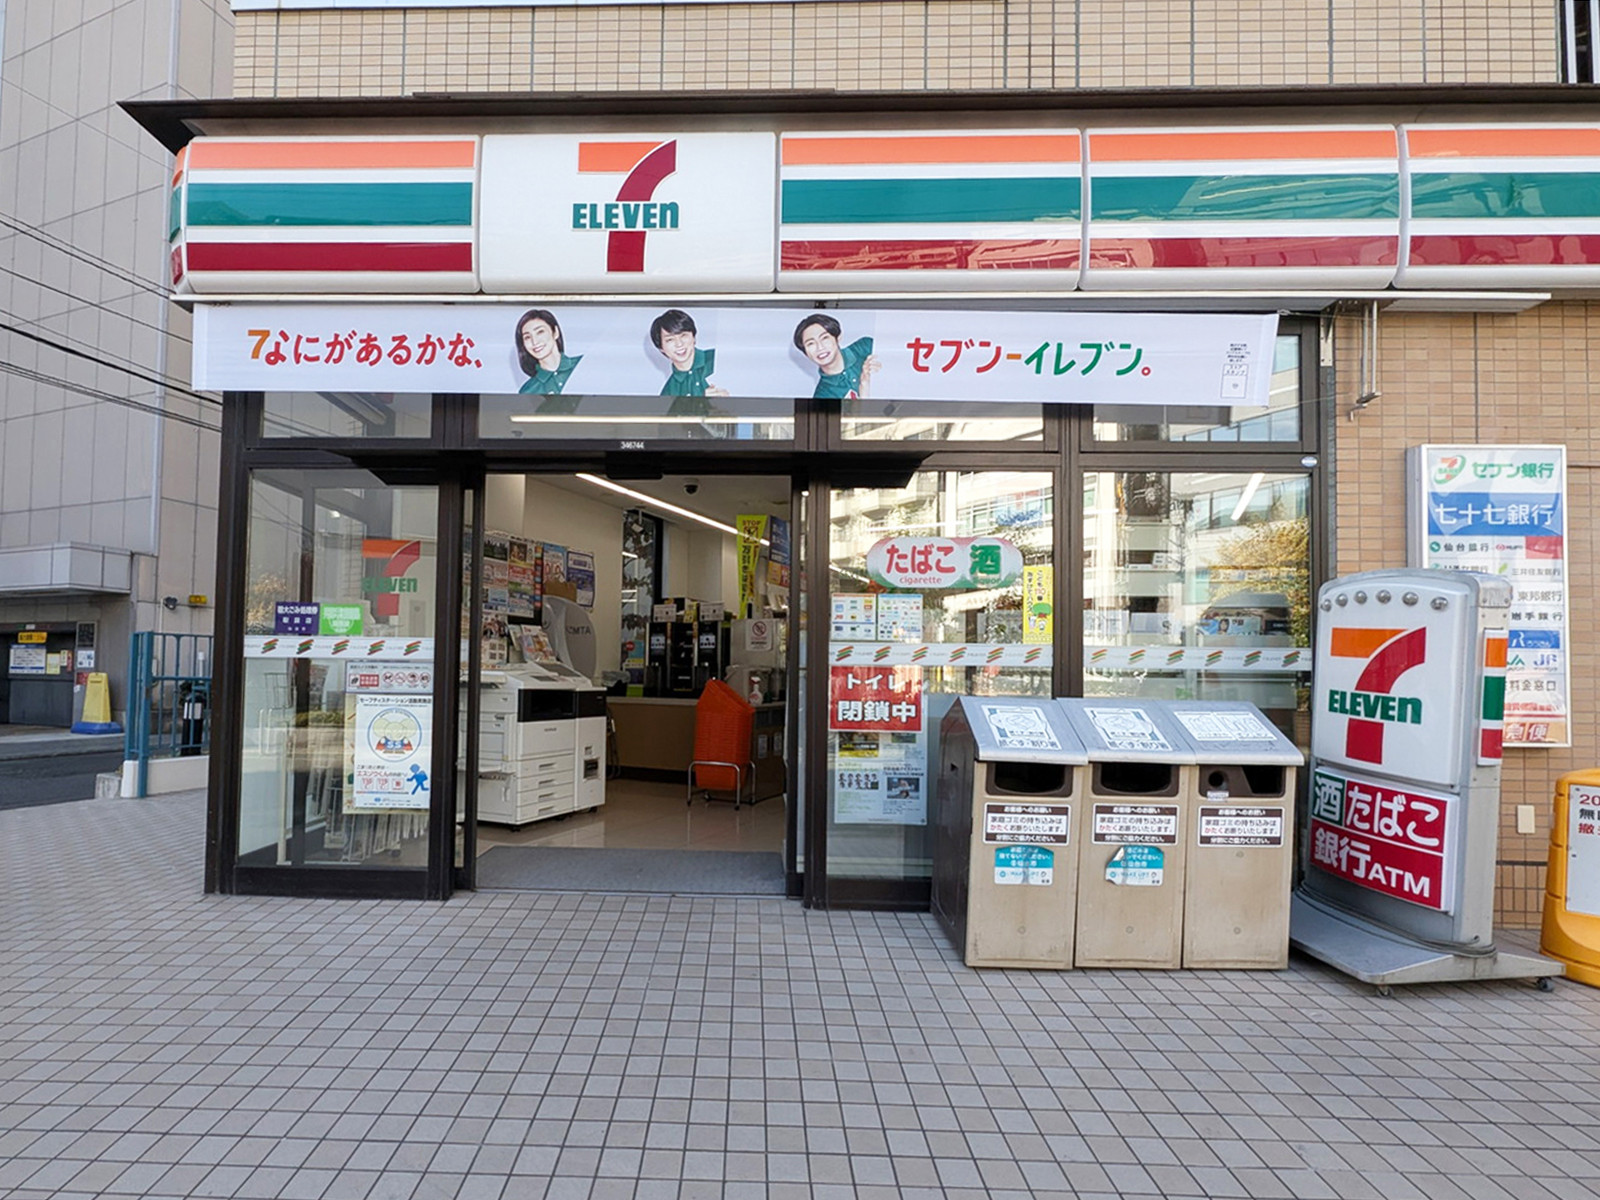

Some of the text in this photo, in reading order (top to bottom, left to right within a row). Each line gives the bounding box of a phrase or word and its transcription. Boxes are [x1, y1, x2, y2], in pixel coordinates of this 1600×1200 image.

[578, 139, 677, 272] 7
[1435, 503, 1554, 526] 七十七銀行
[886, 543, 1002, 576] たばこ 酒
[362, 539, 421, 616] 7
[899, 575, 943, 586] cigarette
[1330, 626, 1427, 765] 7
[837, 700, 917, 723] 閉鎖中
[990, 816, 1062, 824] 家庭ゴミの持ち込みは
[1099, 816, 1171, 824] 家庭ゴミの持ち込みは
[1205, 819, 1277, 827] 家庭ゴミの持ち込みは
[1313, 775, 1441, 848] 酒 たばこ
[1579, 808, 1600, 821] 無
[1313, 826, 1431, 899] 銀行ATM
